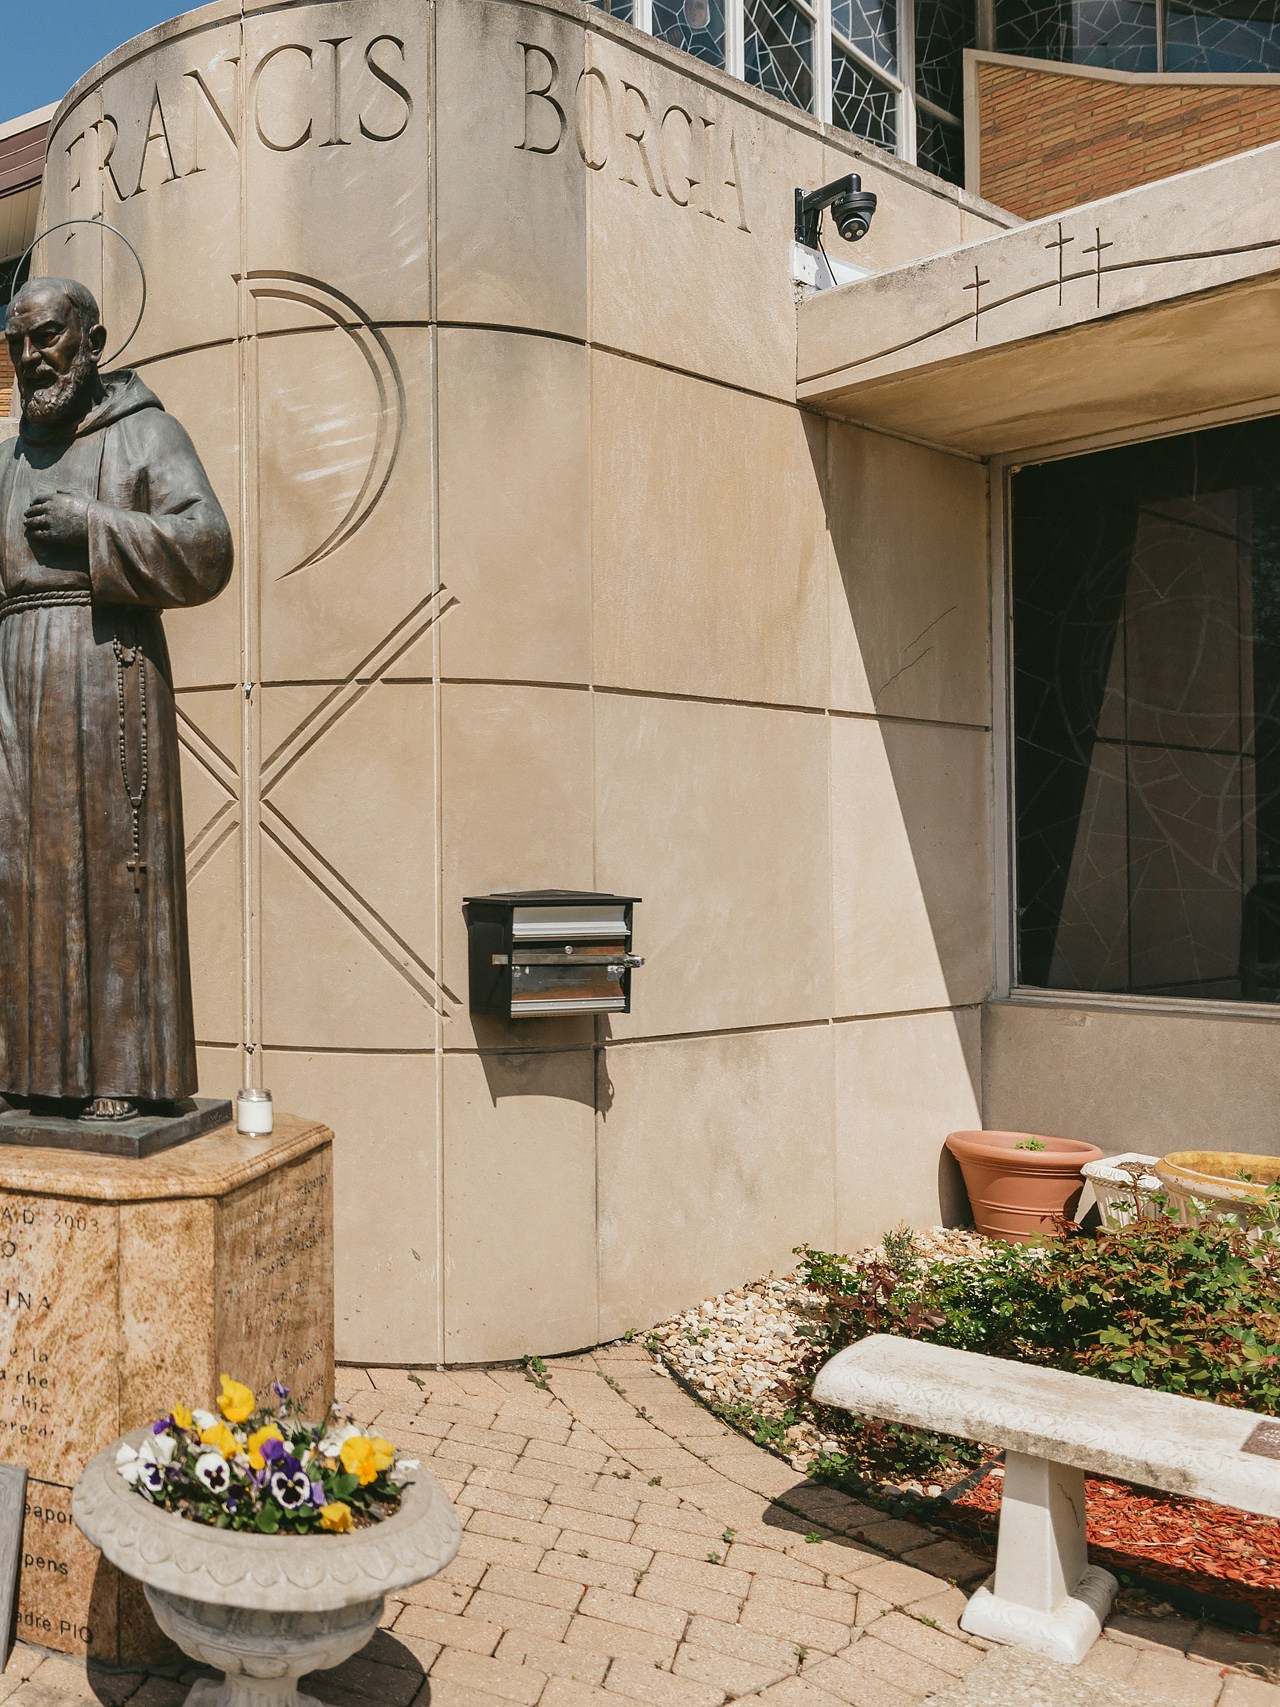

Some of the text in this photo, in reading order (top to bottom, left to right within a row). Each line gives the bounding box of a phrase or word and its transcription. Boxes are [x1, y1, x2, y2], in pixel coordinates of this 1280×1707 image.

[65, 34, 752, 245] FRANCIS BORGIA
[32, 1348, 49, 1363] la
[15, 1371, 48, 1389] che
[25, 1504, 73, 1524] eapo
[25, 1553, 68, 1575] pens
[17, 1612, 93, 1644] adre PIO
